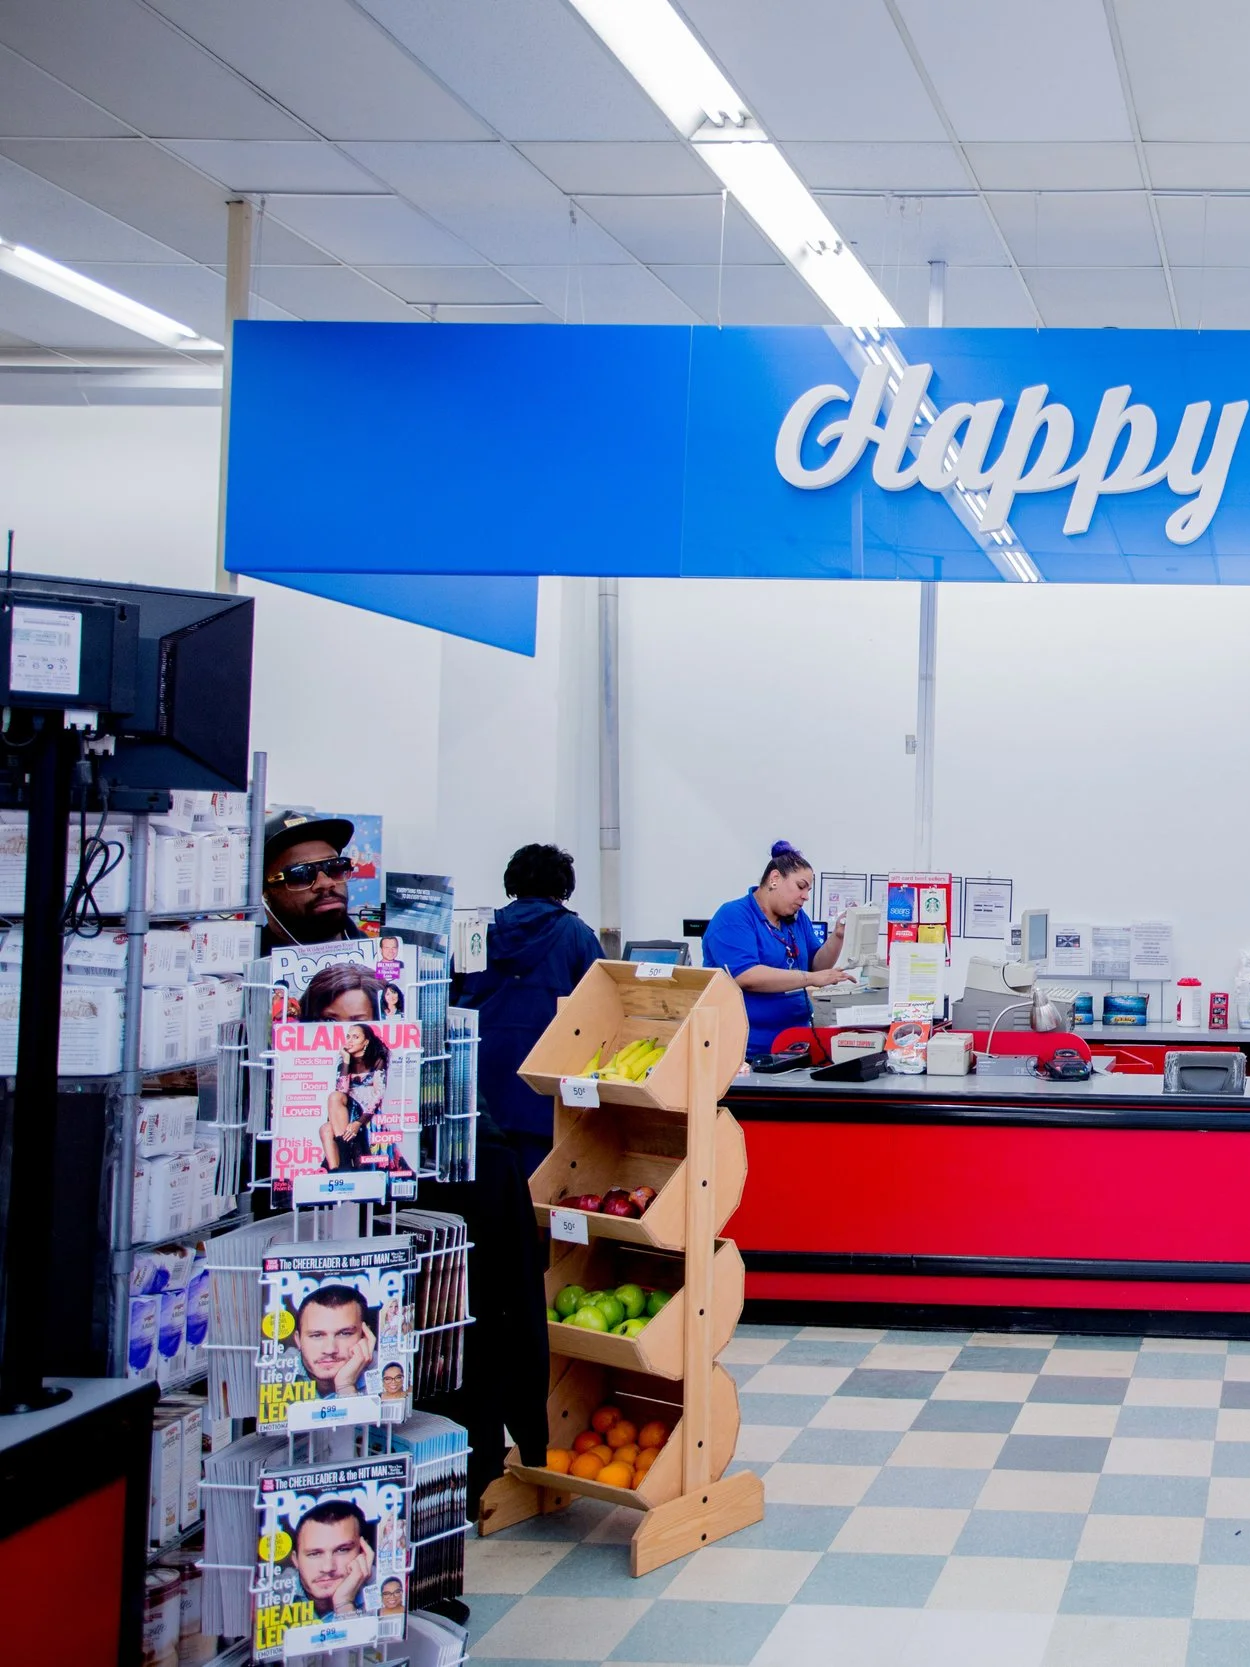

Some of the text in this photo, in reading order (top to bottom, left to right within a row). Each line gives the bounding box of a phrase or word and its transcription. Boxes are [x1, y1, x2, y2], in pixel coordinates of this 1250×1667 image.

[774, 363, 1250, 546] Happy
[276, 1024, 421, 1051] GLAMUR
[295, 1057, 333, 1065] Rock Stars
[302, 1082, 327, 1090] Doers
[573, 1087, 586, 1096] 50¢
[284, 1106, 320, 1117] Lovers
[275, 1138, 300, 1147] This
[371, 1132, 402, 1143] Icons
[275, 1147, 322, 1164] OUR
[563, 1221, 576, 1231] 50¢
[280, 1259, 292, 1269] The
[293, 1257, 340, 1269] CHEERLEADER
[342, 1257, 348, 1267] &
[349, 1256, 360, 1267] the
[361, 1255, 373, 1265] HIT
[374, 1253, 390, 1264] MAN
[261, 1340, 284, 1354] The
[260, 1354, 299, 1369] Secret
[260, 1369, 299, 1384] Life of
[259, 1381, 316, 1403] HEATH
[275, 1479, 287, 1490] The
[288, 1474, 338, 1487] CHEERLEADER
[339, 1471, 345, 1482] &
[346, 1470, 357, 1480] the
[358, 1467, 370, 1479] HIT
[371, 1465, 387, 1478] MAN
[259, 1563, 281, 1577] The
[257, 1577, 297, 1590] Secret
[258, 1591, 295, 1607] Life of
[256, 1600, 314, 1630] HEATH
